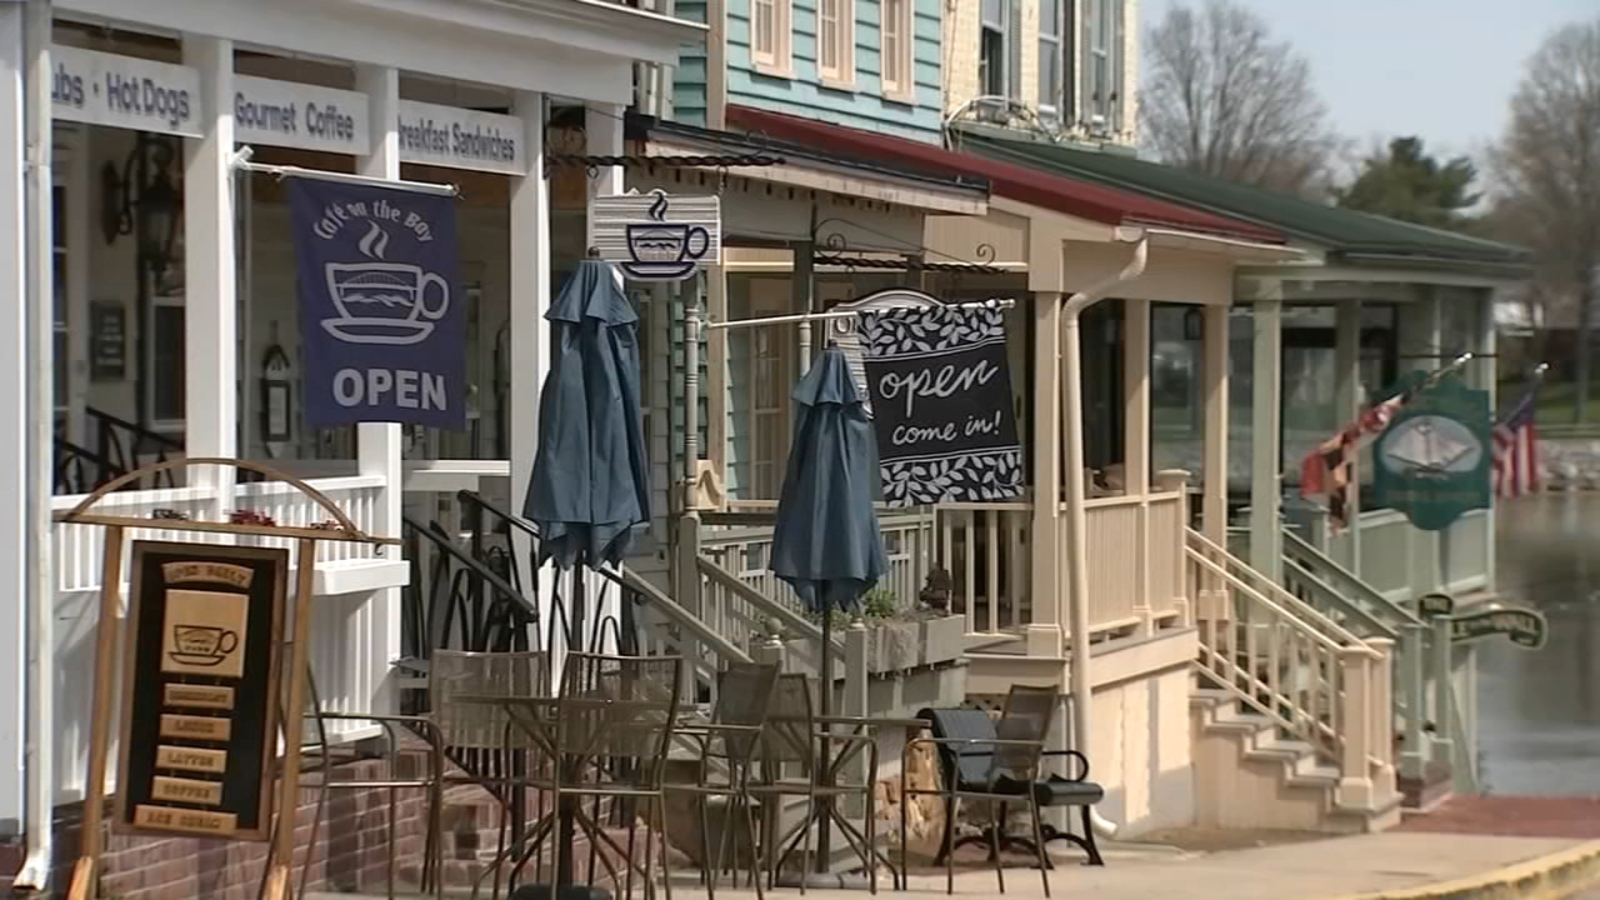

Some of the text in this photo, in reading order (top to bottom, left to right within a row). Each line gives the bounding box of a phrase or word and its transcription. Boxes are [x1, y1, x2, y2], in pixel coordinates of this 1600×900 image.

[51, 62, 84, 109] ubs
[143, 78, 190, 128] Dogs
[234, 92, 354, 140] Gourmet Coffee
[398, 115, 515, 162] reakfast Sandwiches
[372, 200, 401, 222] the
[404, 211, 435, 242] Bay
[333, 368, 447, 411] OPEN
[879, 360, 998, 418] open
[892, 410, 1001, 445] come in!
